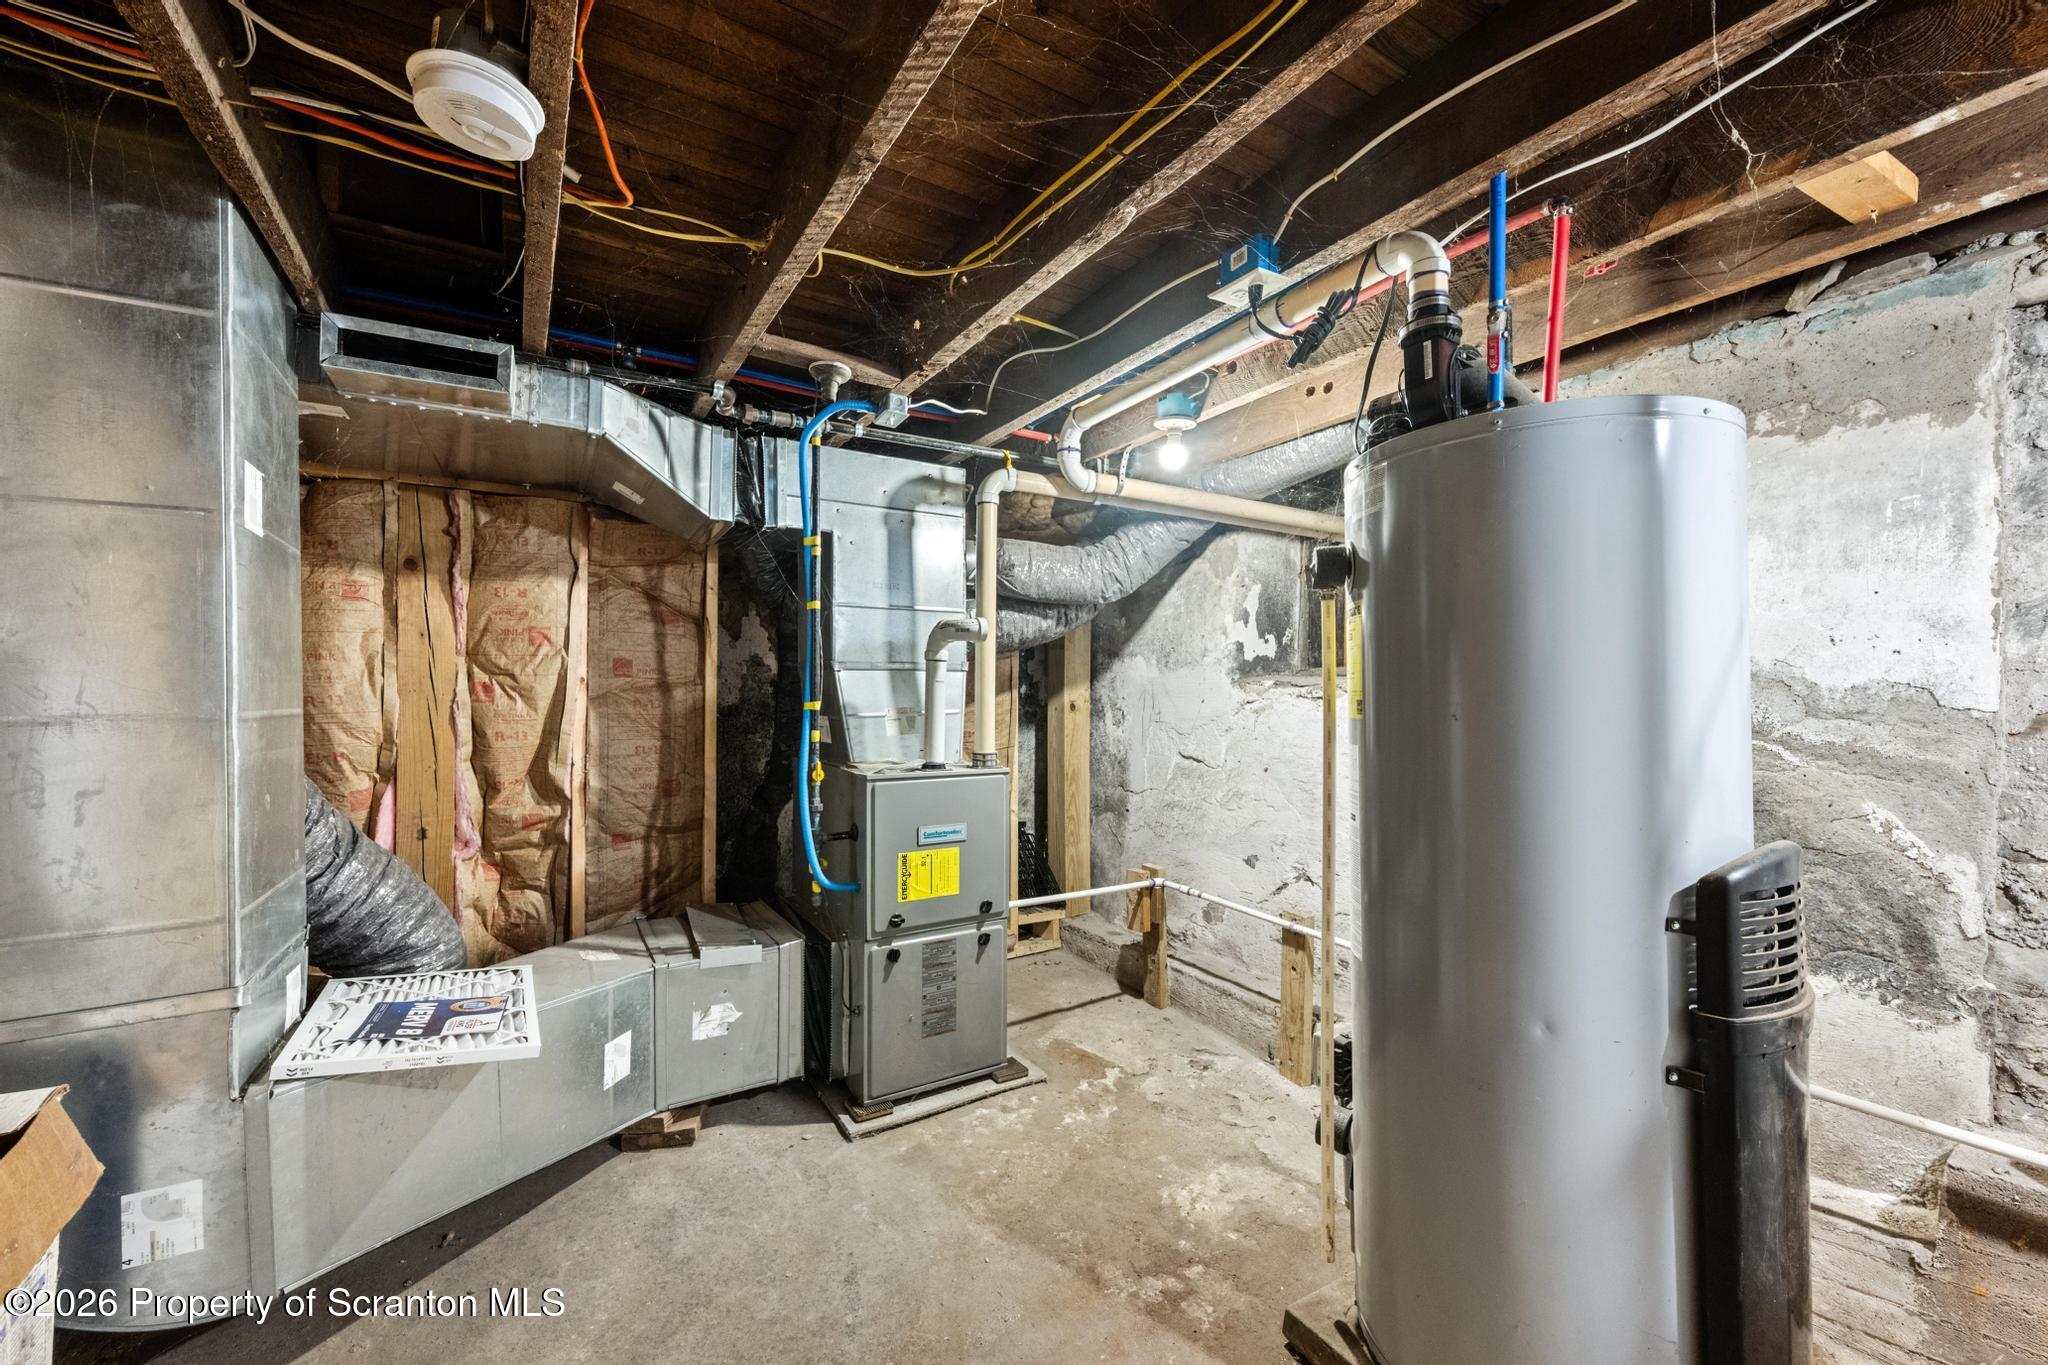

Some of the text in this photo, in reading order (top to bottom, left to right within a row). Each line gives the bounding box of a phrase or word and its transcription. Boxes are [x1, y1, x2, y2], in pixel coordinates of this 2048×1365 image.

[494, 587, 529, 599] R-13
[494, 731, 529, 742] R-13
[400, 1002, 439, 1028] MERV
[395, 1028, 424, 1036] 8
